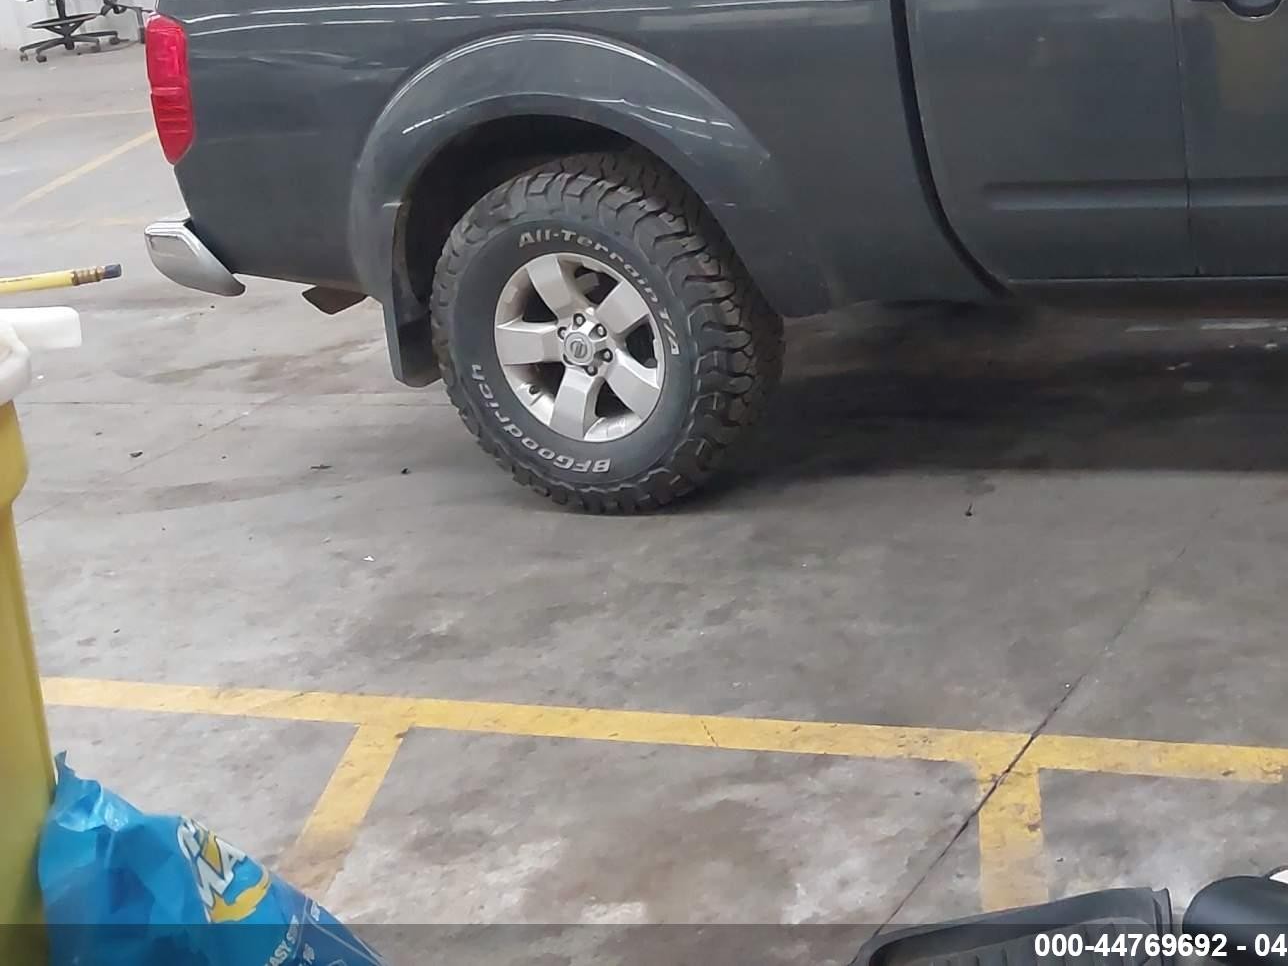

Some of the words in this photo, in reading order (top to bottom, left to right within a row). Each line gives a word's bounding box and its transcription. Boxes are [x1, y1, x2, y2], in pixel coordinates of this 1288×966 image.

[518, 228, 661, 306] All-Terrain
[658, 306, 680, 356] T/A
[470, 363, 612, 474] BFGoodrich
